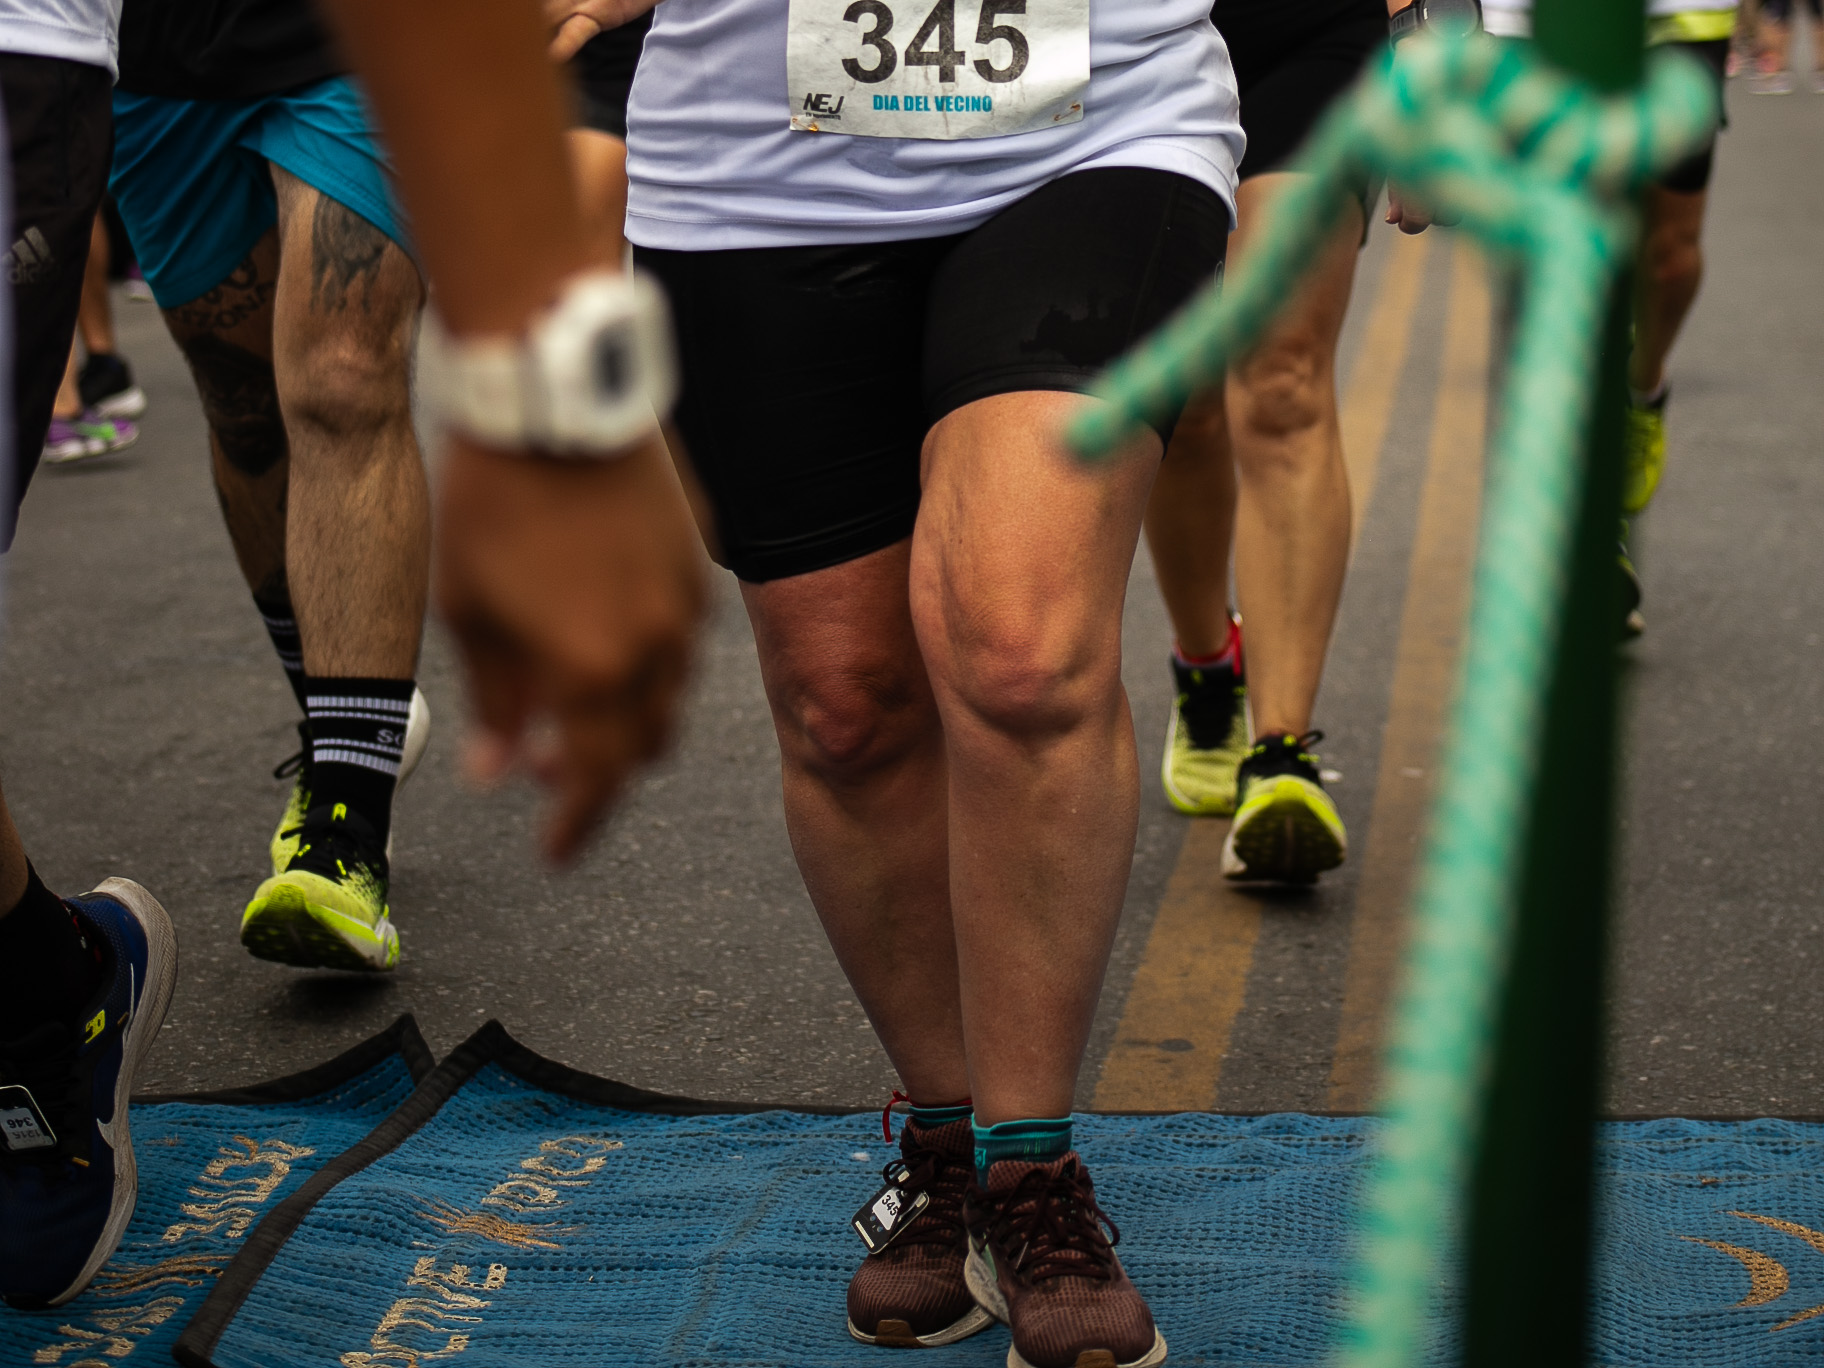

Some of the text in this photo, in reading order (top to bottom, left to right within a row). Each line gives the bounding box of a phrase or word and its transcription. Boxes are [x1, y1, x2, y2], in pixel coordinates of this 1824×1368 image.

[803, 92, 844, 114] NEJ
[873, 94, 993, 113] DIA DEL VECINO
[7, 1116, 33, 1129] 346
[881, 1194, 899, 1216] 345
